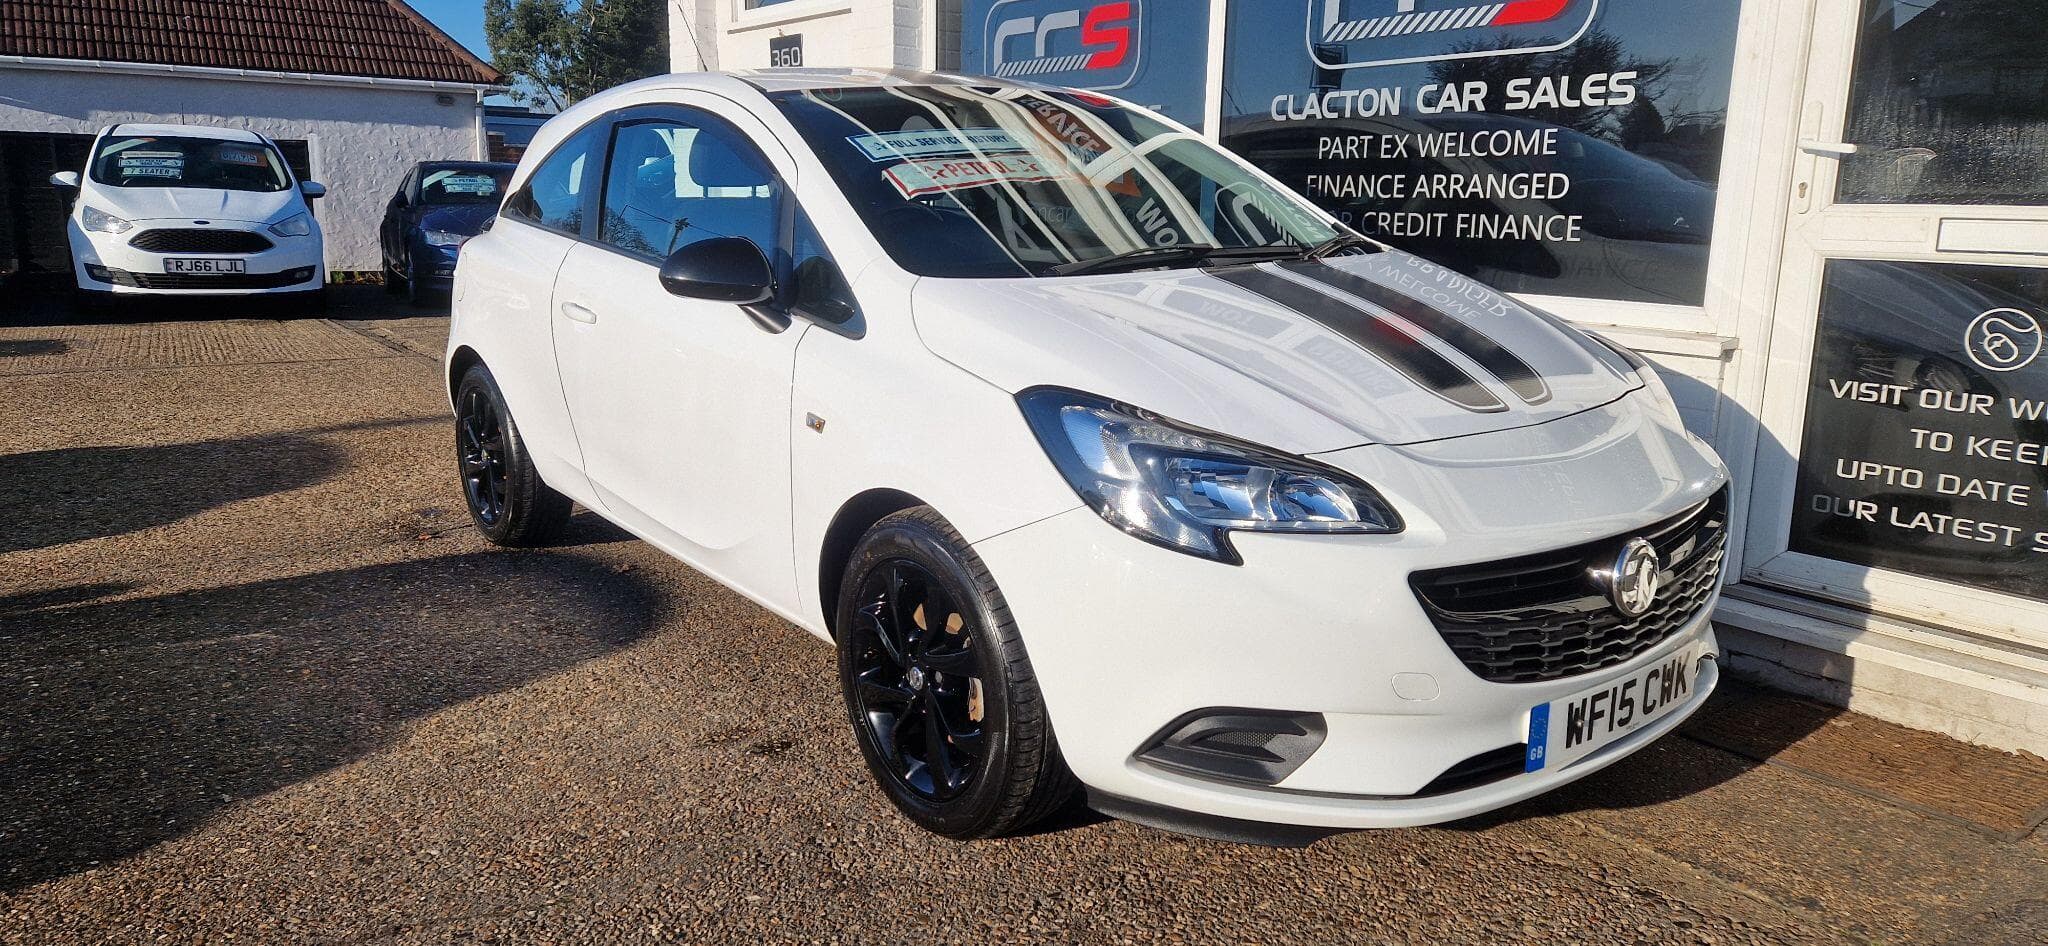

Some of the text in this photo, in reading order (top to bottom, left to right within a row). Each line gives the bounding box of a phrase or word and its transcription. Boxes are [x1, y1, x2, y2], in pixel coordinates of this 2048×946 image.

[772, 47, 801, 67] 360
[1271, 71, 1638, 121] CLACTON CAR SALES
[886, 140, 917, 148] FULL
[1318, 128, 1558, 160] PART EX WELCOME
[1306, 172, 1570, 200] FINANCE ARRANGED
[1361, 211, 1448, 237] CREDIT
[175, 260, 243, 272] RJ66 LJL
[1828, 378, 2048, 421] VISIT OUR W
[1910, 428, 1953, 452] TO
[1836, 458, 1923, 489] UPTO
[1936, 474, 2031, 506] DATE
[1812, 494, 1878, 523] OUR
[1890, 506, 2021, 547] LATEST
[1565, 650, 1691, 749] WF15 CWK
[1530, 746, 1543, 761] GB
